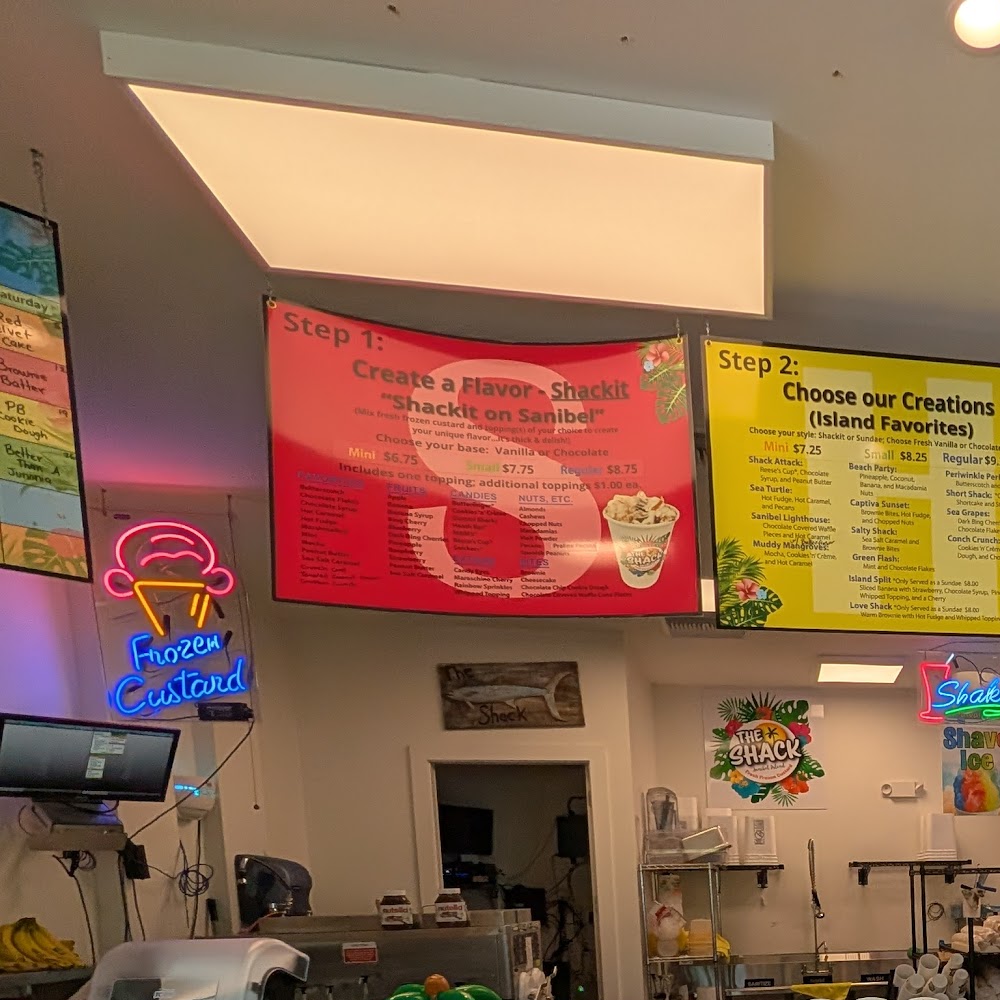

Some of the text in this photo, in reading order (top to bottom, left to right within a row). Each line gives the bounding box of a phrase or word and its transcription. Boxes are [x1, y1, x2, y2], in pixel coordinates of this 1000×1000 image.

[0, 291, 48, 312] aturday
[283, 311, 384, 351] Step 1:
[719, 349, 799, 378] Step 2:
[352, 359, 629, 401] Create a Flavor Shackit
[783, 381, 996, 416] Choose our Creations
[484, 408, 512, 421] on
[749, 426, 776, 436] Choose
[810, 410, 974, 440] (Island Favorites)
[376, 433, 609, 458] Choose your Vanilla Chocolate
[764, 440, 789, 452] Mini
[793, 444, 822, 455] $7.25
[348, 447, 376, 460] Mini
[383, 450, 419, 466] $6.75
[864, 449, 895, 461] Small
[900, 451, 928, 462] $8.25
[942, 452, 983, 466] Regular
[748, 455, 803, 467] Shack Attack:
[849, 463, 873, 472] Beach
[502, 463, 535, 475] $7.75
[606, 463, 638, 475] $8.75
[339, 461, 591, 492] Includes additional toppings
[850, 499, 910, 509] Captiva Sunset:
[947, 535, 971, 543] Conch
[131, 633, 222, 671] Frozen
[115, 658, 246, 714] Custard
[735, 729, 763, 744] THE
[728, 737, 803, 767] SHACK
[960, 749, 995, 771] Ice
